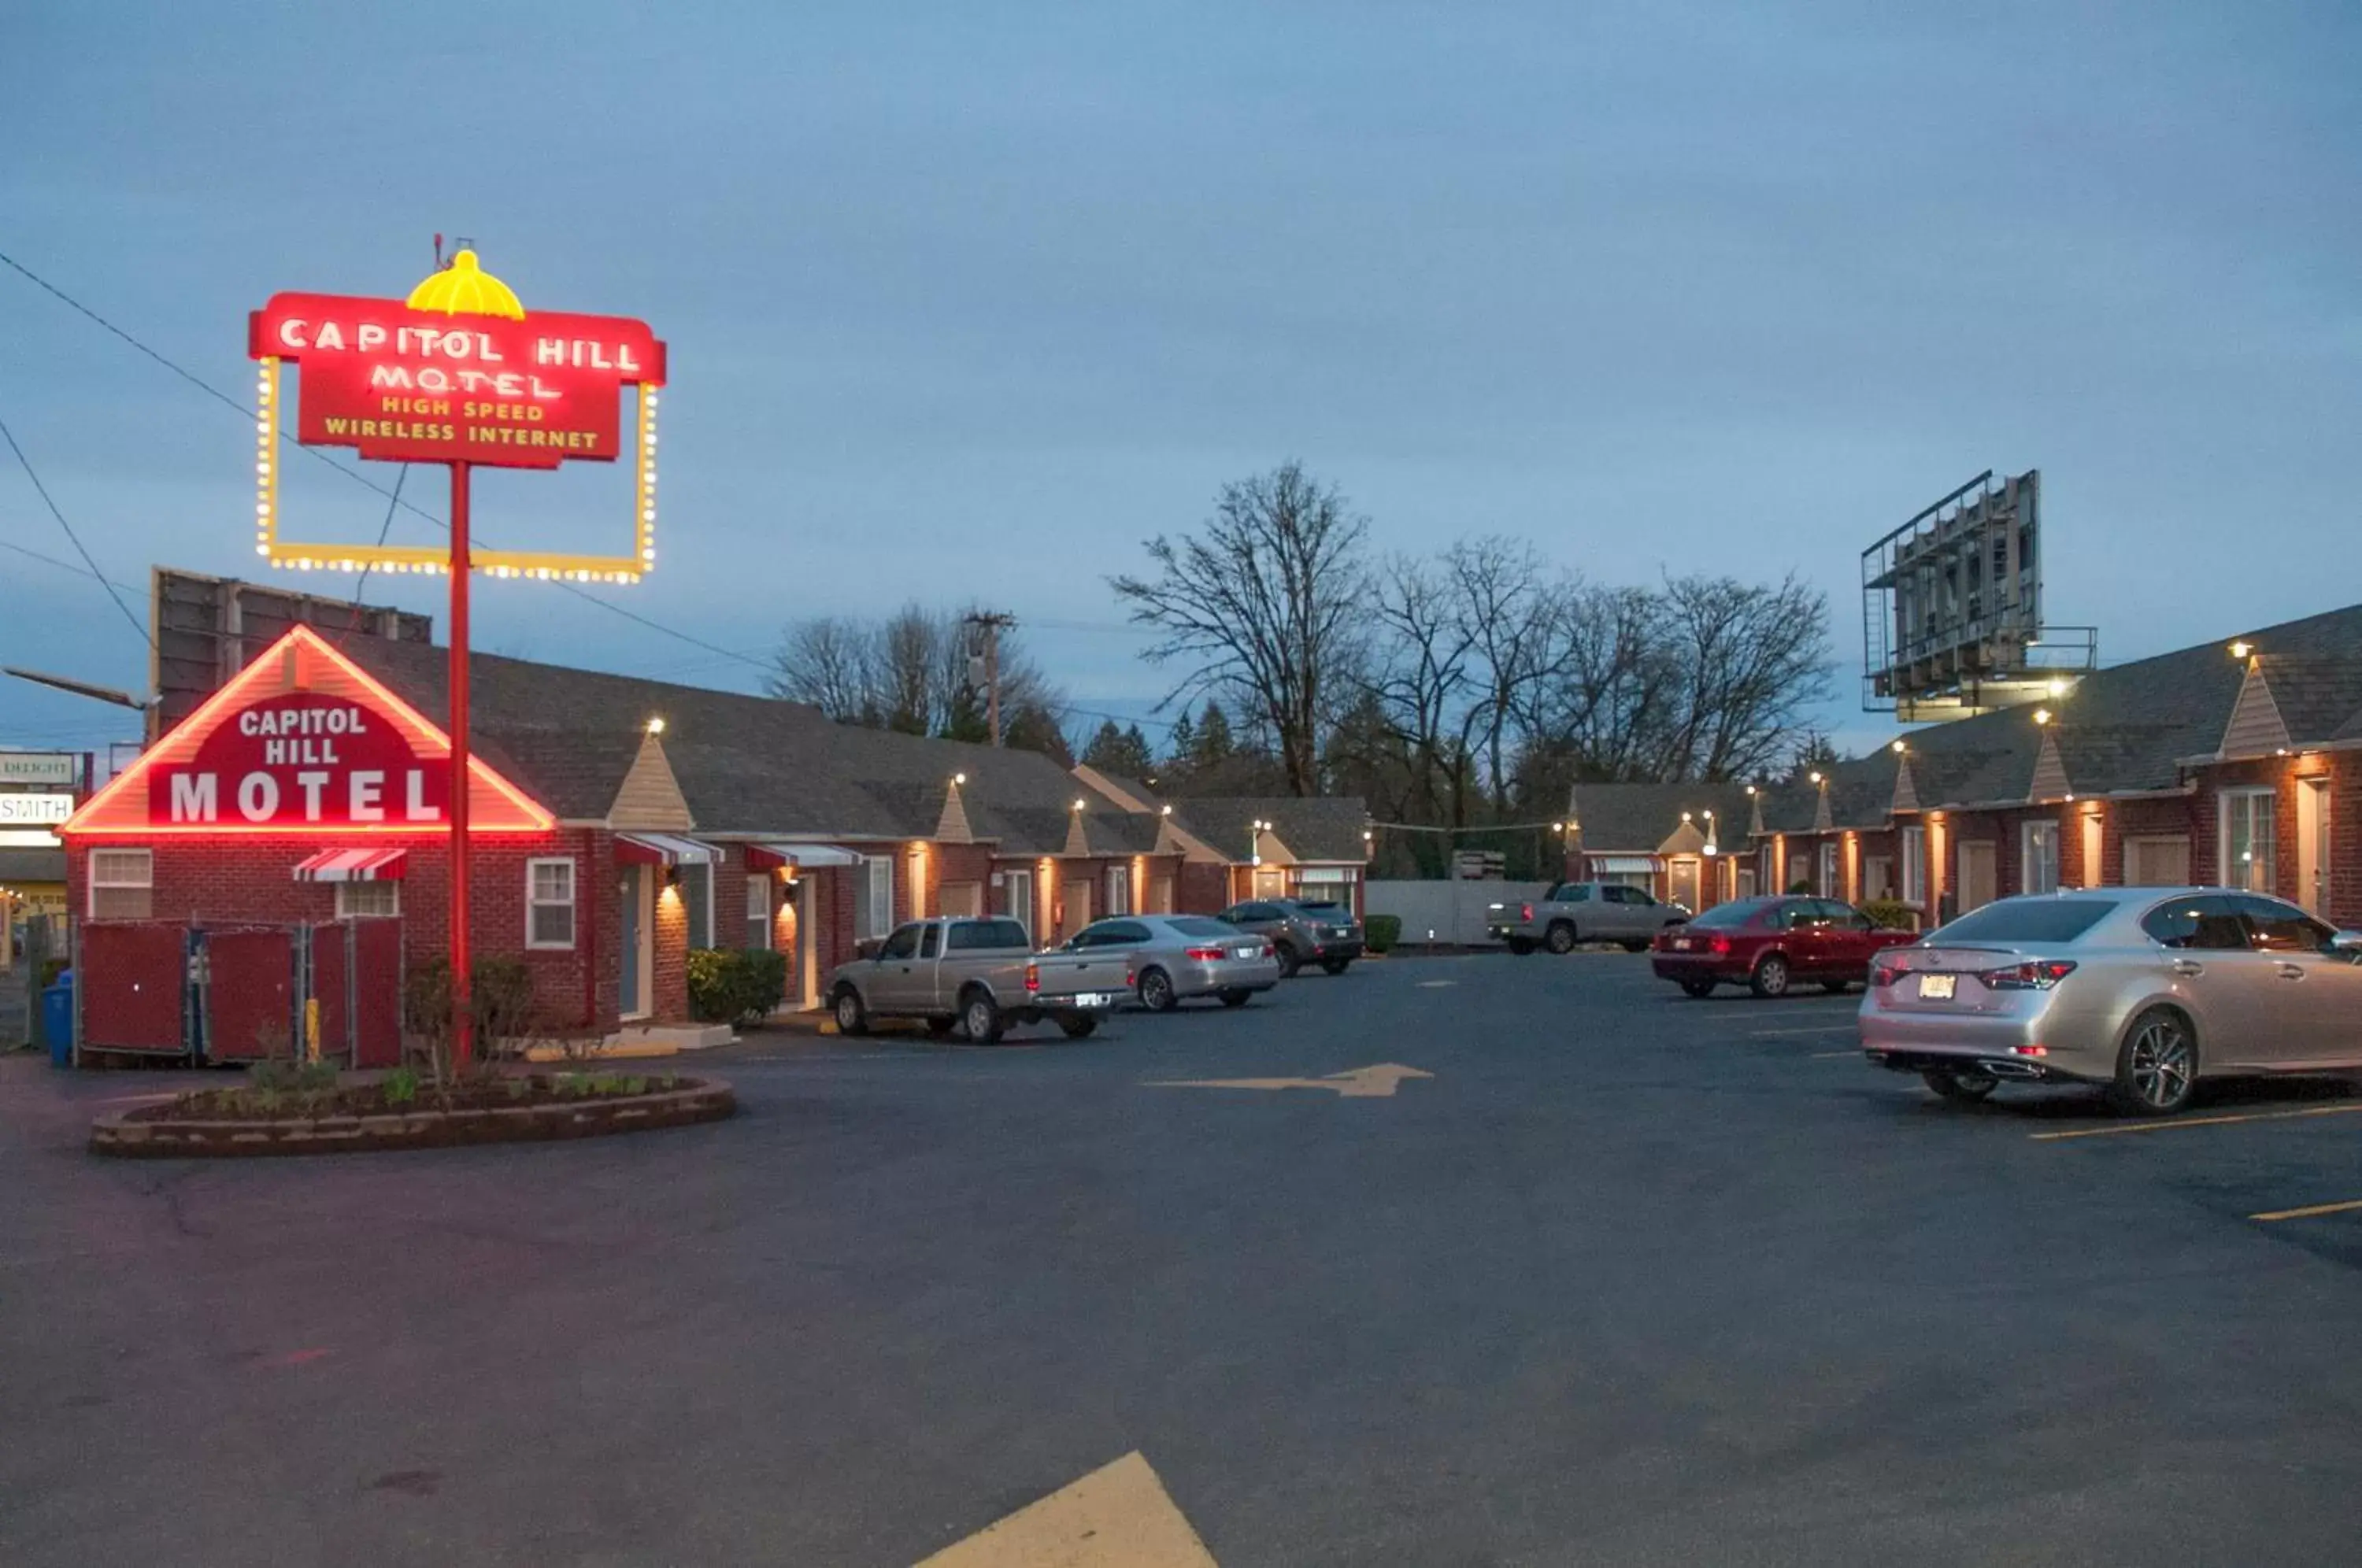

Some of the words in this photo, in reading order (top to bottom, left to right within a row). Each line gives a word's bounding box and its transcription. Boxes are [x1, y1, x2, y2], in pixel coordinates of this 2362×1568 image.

[280, 318, 503, 361] CAPITOL
[537, 337, 640, 372] HILL
[371, 364, 563, 398] MOTEL
[382, 396, 450, 416] HIGH
[464, 401, 542, 420] SPEED
[325, 418, 454, 440] WIRELESS
[468, 426, 598, 449] INTERNET
[239, 708, 366, 736] CAPITOL
[265, 738, 339, 764] HILL
[2, 799, 67, 818] SMITH
[170, 770, 440, 822] MOTEL
